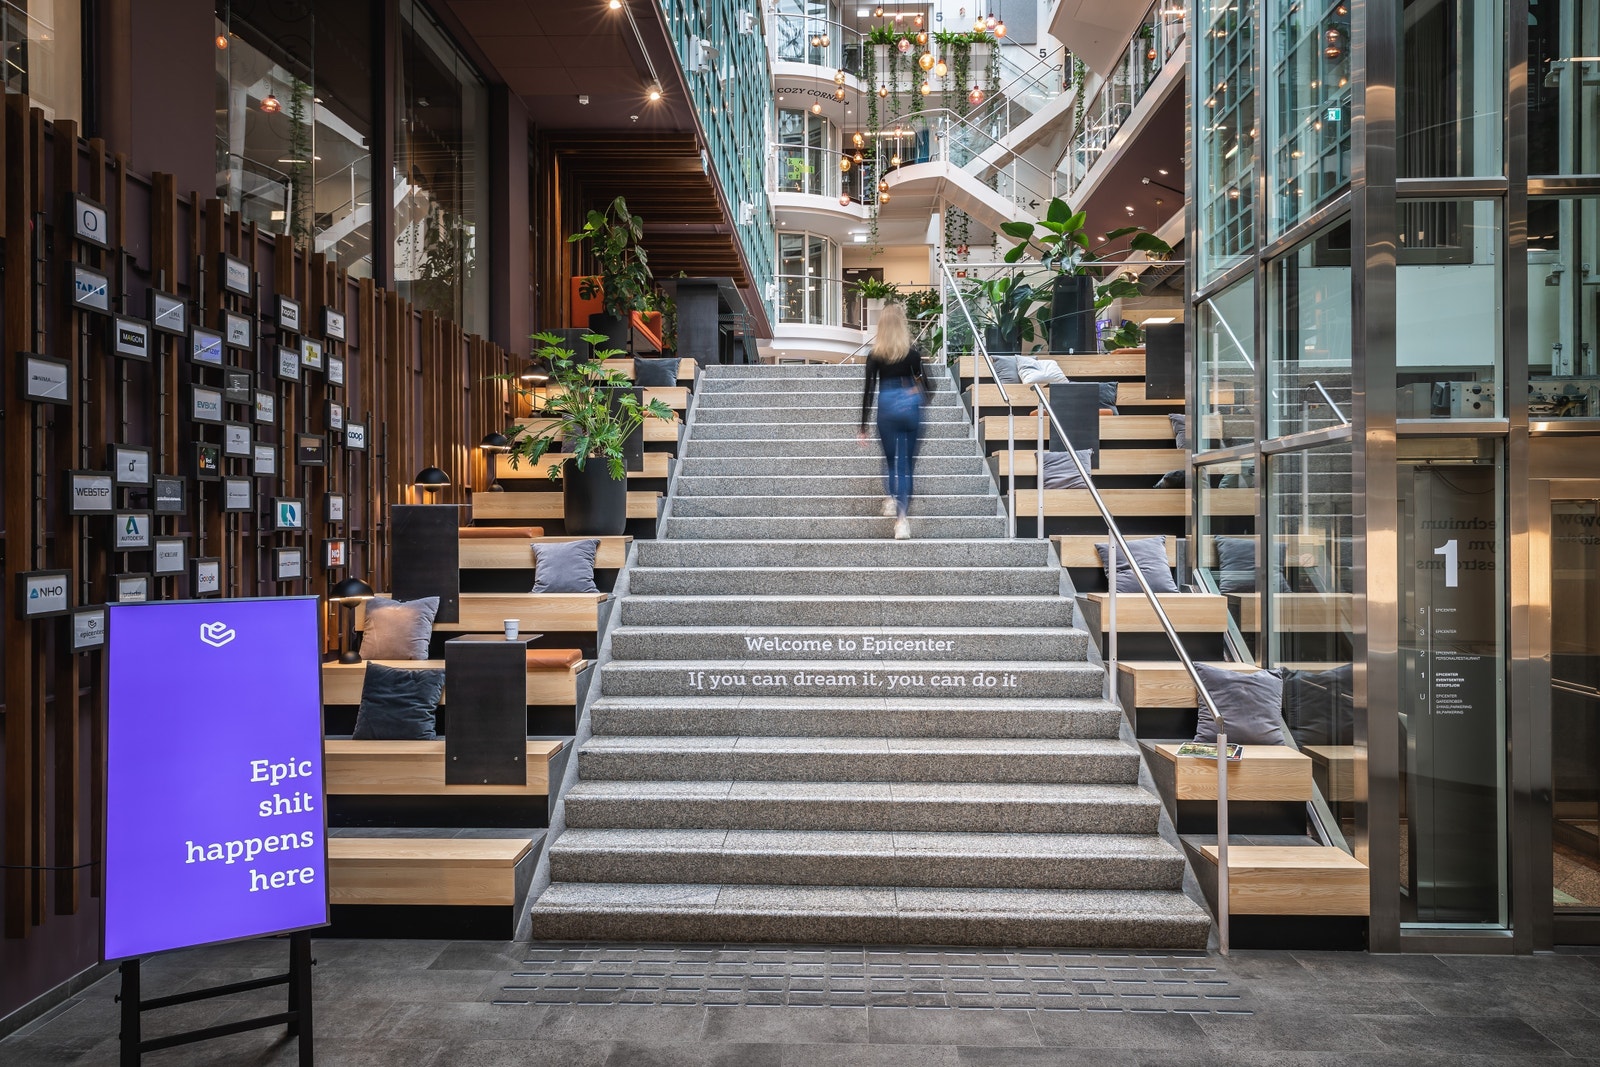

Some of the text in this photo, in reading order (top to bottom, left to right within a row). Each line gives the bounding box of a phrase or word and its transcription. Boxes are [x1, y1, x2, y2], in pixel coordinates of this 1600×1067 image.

[936, 12, 943, 22] 5
[1040, 49, 1047, 58] 5
[123, 332, 143, 344] MAIGON
[197, 401, 217, 410] EVBOX
[349, 432, 362, 441] coop
[75, 488, 110, 496] WEBSTEP
[1434, 540, 1458, 588] 1
[200, 574, 215, 584] Google
[40, 586, 63, 597] NHO
[744, 637, 955, 654] Welcome to Epicenter
[688, 672, 1018, 690] If you can dream it, you can do it
[250, 757, 313, 786] Epic
[259, 792, 314, 817] shit
[185, 831, 314, 865] happens
[249, 866, 315, 892] here
